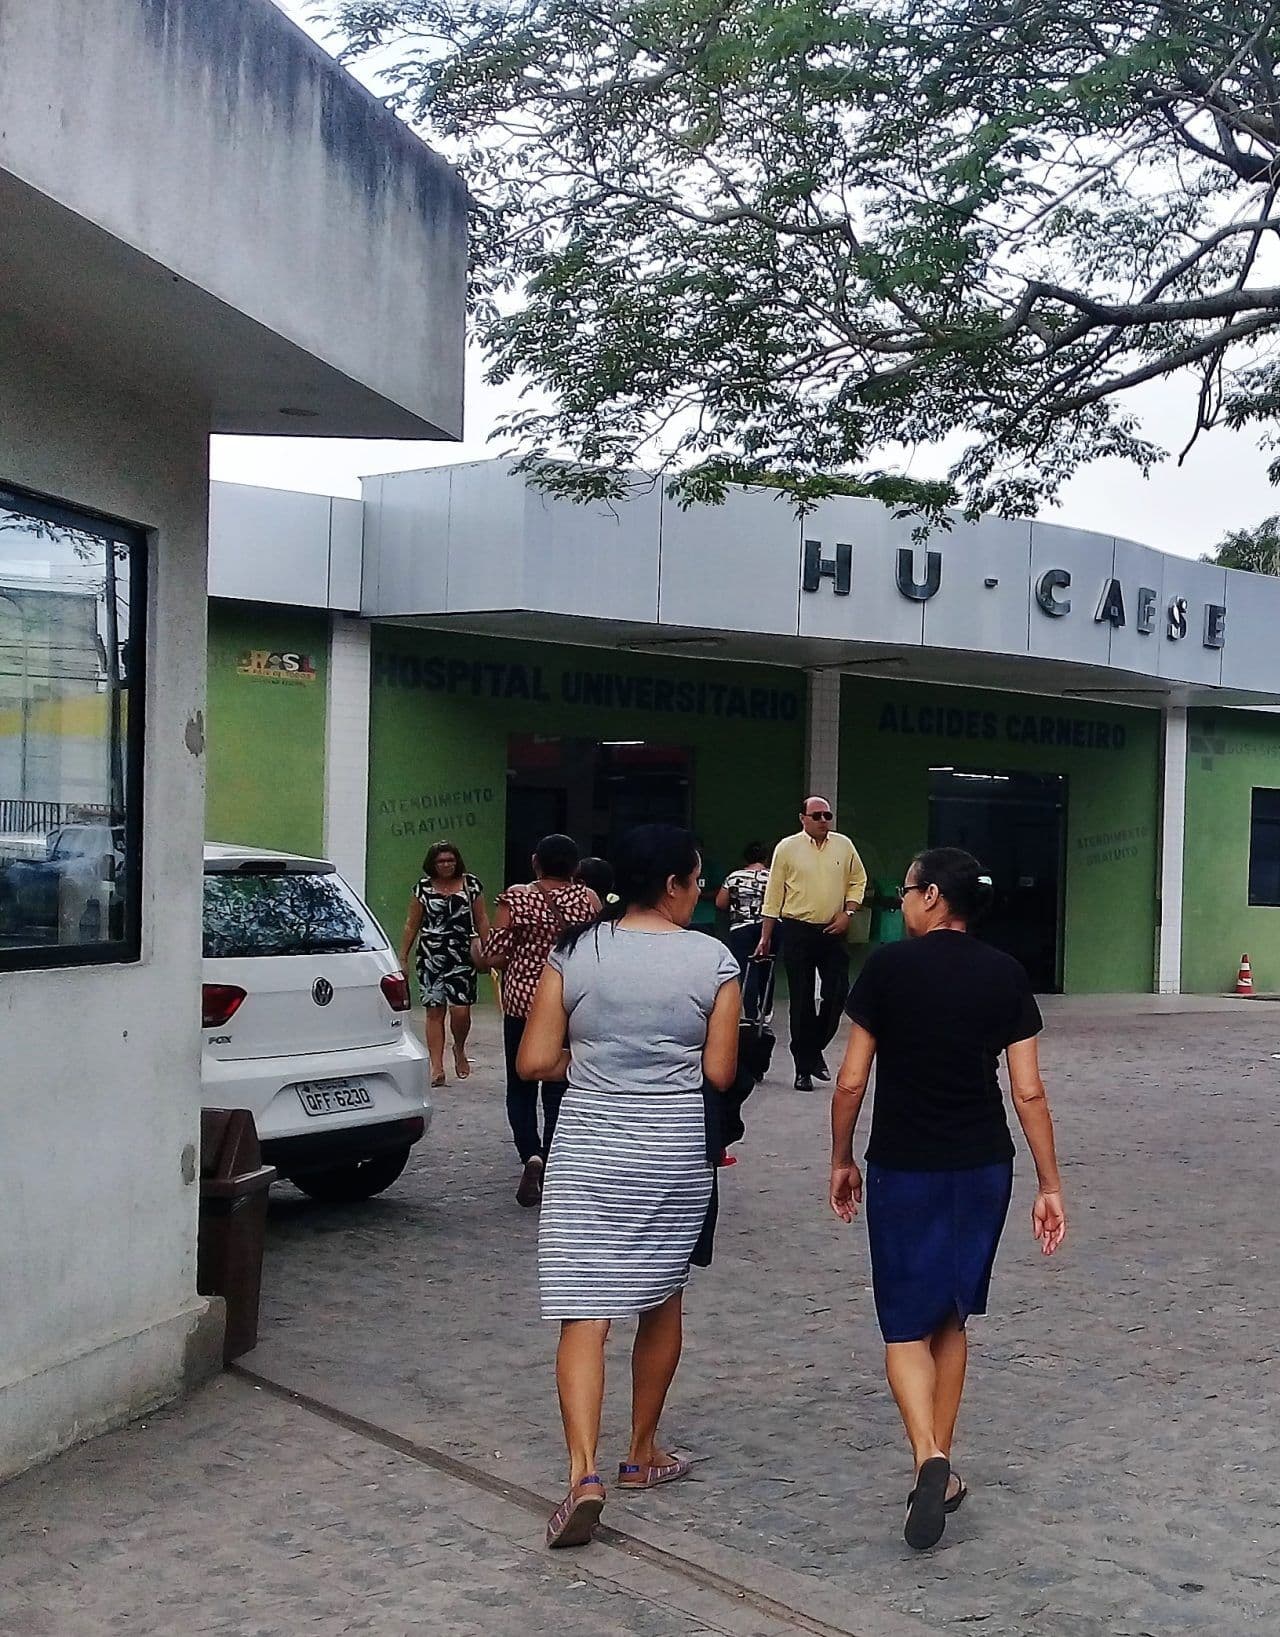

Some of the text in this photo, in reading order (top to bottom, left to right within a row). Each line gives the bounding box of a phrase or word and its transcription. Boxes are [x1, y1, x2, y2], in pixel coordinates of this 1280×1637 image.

[803, 540, 942, 600] HU
[1035, 569, 1227, 649] CAESE
[375, 651, 551, 703] HOSPITAL
[878, 703, 1126, 749] ALCIDES CARNEIRO
[391, 812, 476, 837] GRATUITO
[208, 1036, 232, 1044] FOX
